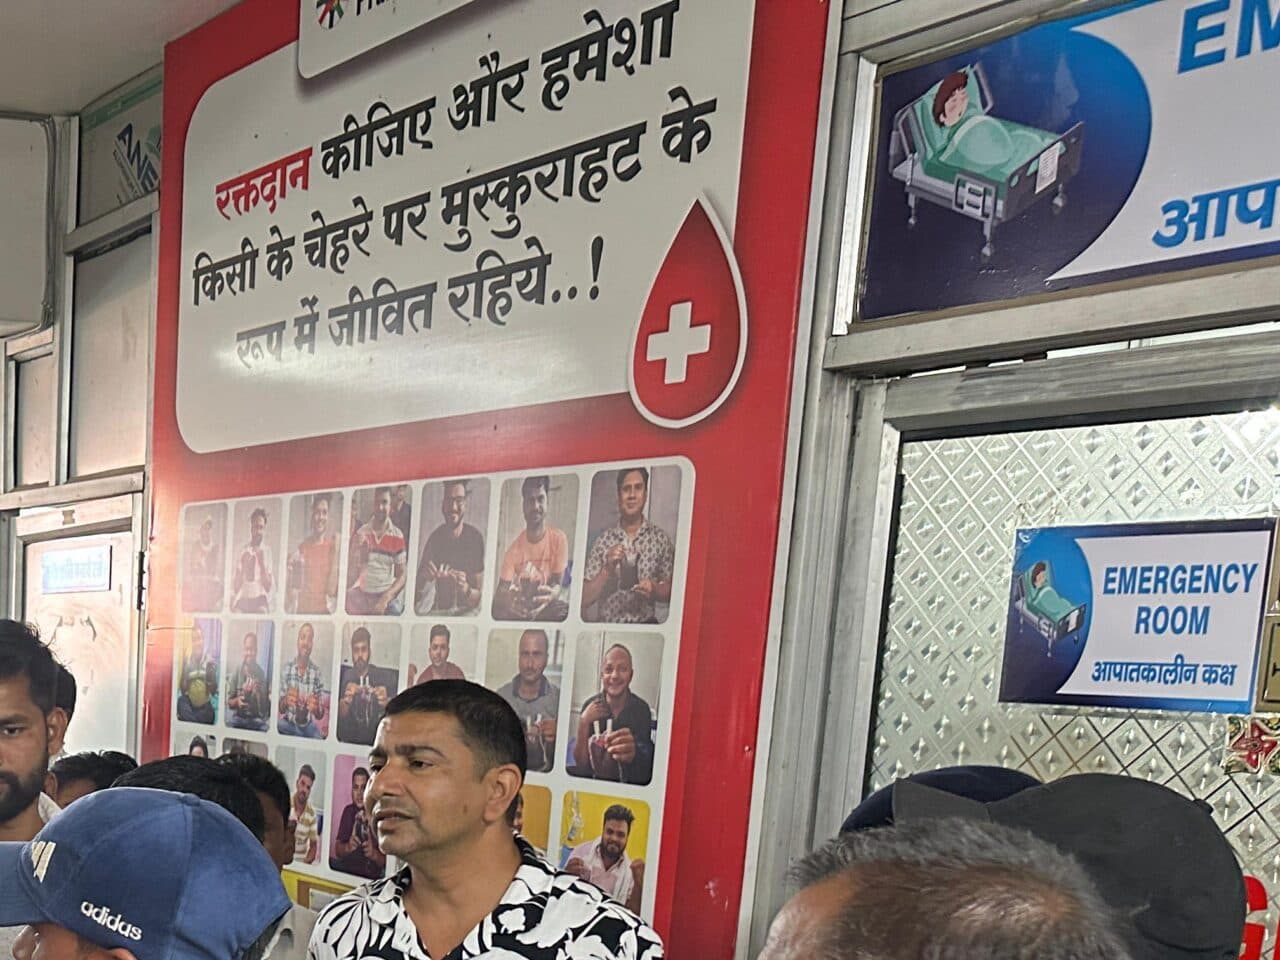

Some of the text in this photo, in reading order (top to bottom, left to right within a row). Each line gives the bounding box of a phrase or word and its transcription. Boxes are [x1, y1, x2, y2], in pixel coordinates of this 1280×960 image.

[215, 146, 312, 221] रक्तदान
[321, 96, 437, 181] कीजिए
[447, 50, 529, 130] और
[542, 0, 680, 111] हमेशा
[193, 86, 718, 306] किसी के चेहरे पर मुस्कुराहट के
[236, 319, 286, 370] रूप
[293, 296, 320, 356] में
[328, 274, 437, 349] जीवित
[1103, 563, 1258, 595] EMERGENCY
[1135, 605, 1210, 635] ROOM
[1091, 653, 1237, 686] आपातकालीन कक्ष
[80, 900, 143, 941] adidas
